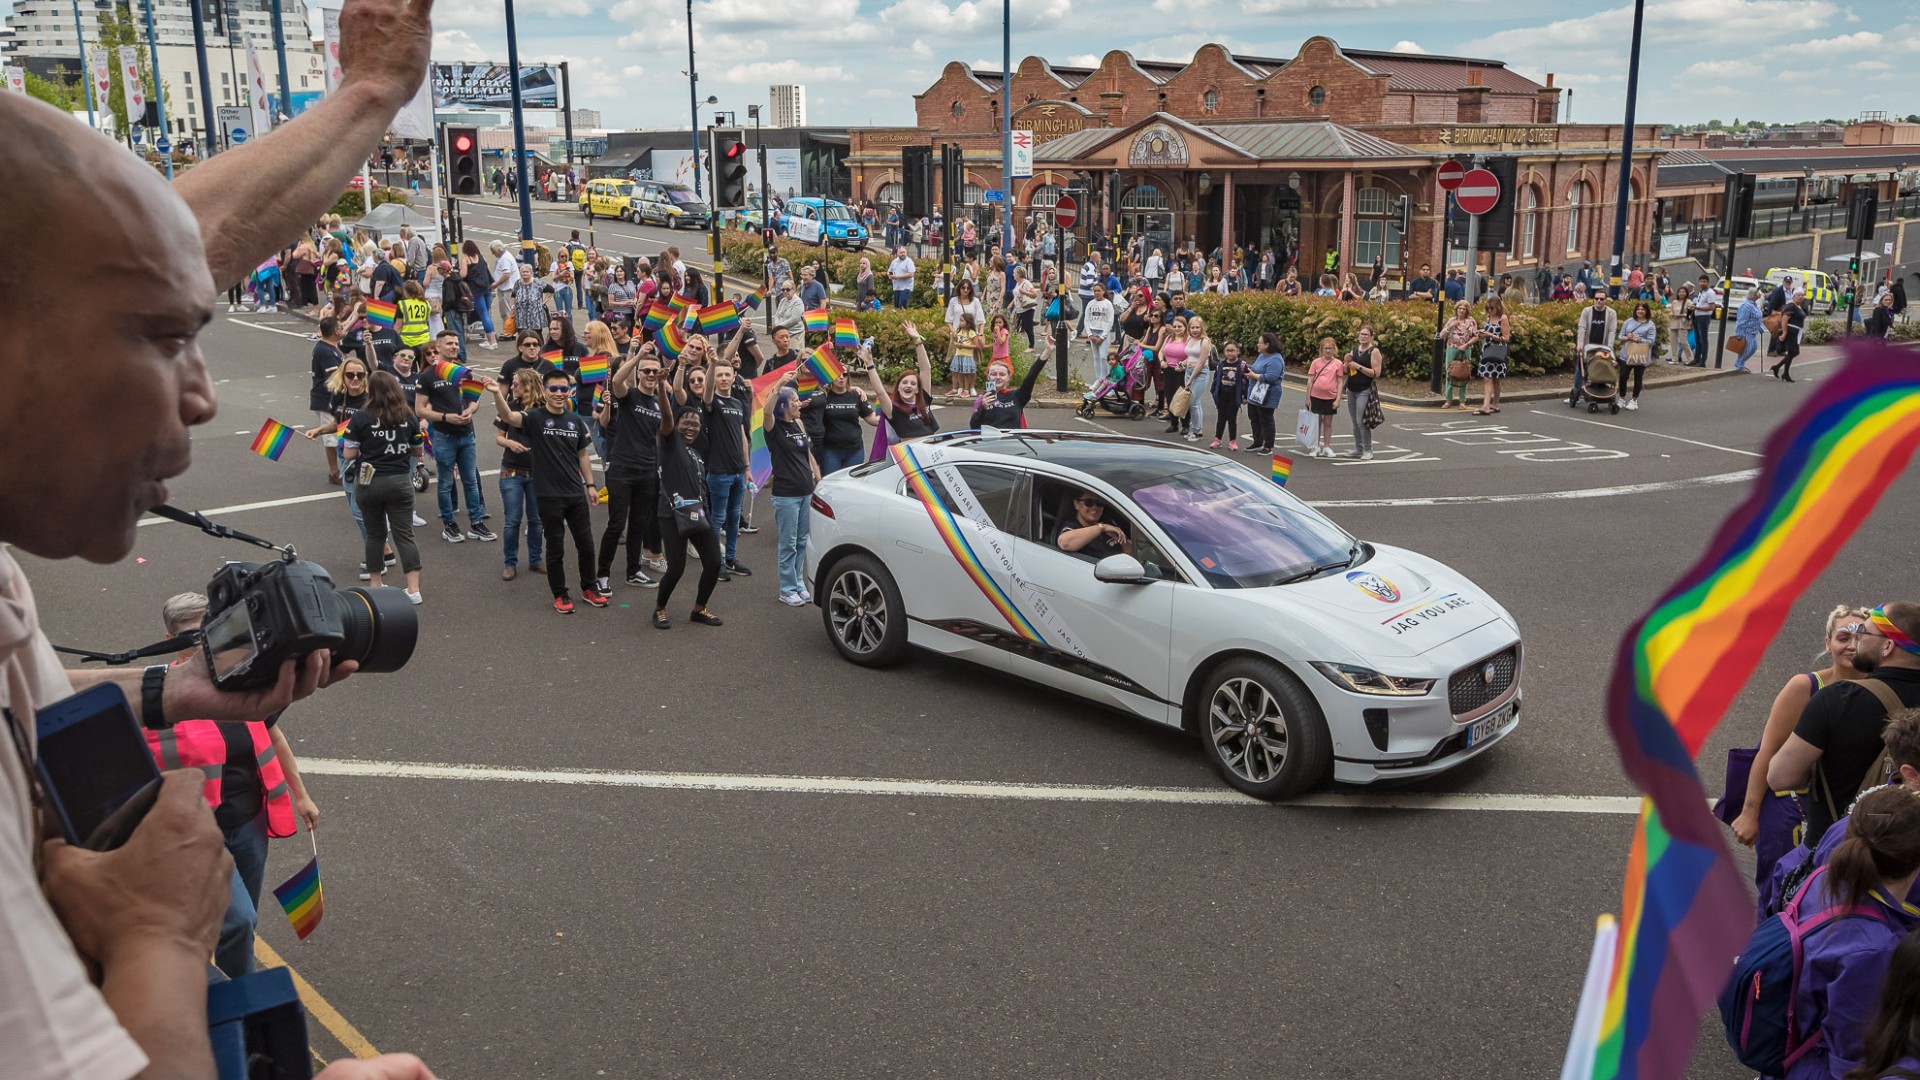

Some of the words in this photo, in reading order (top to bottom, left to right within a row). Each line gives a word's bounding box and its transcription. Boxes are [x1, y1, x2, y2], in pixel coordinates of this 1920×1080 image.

[442, 86, 455, 94] OF
[464, 80, 511, 88] OPERATO
[1016, 118, 1083, 132] BIRMINGHAM
[1454, 128, 1504, 144] BIRMINGHAM
[1506, 128, 1527, 143] MOOR
[1529, 128, 1558, 143] STREET
[408, 304, 426, 318] 129
[372, 430, 396, 442] YOU
[944, 470, 954, 482] JAG
[954, 482, 964, 496] YOU
[990, 540, 1002, 554] JAG
[1001, 554, 1012, 571] YOU
[1391, 616, 1420, 634] JAG
[1416, 606, 1446, 620] YOU
[1058, 628, 1072, 644] JAG
[1104, 674, 1132, 687] JAGUAR
